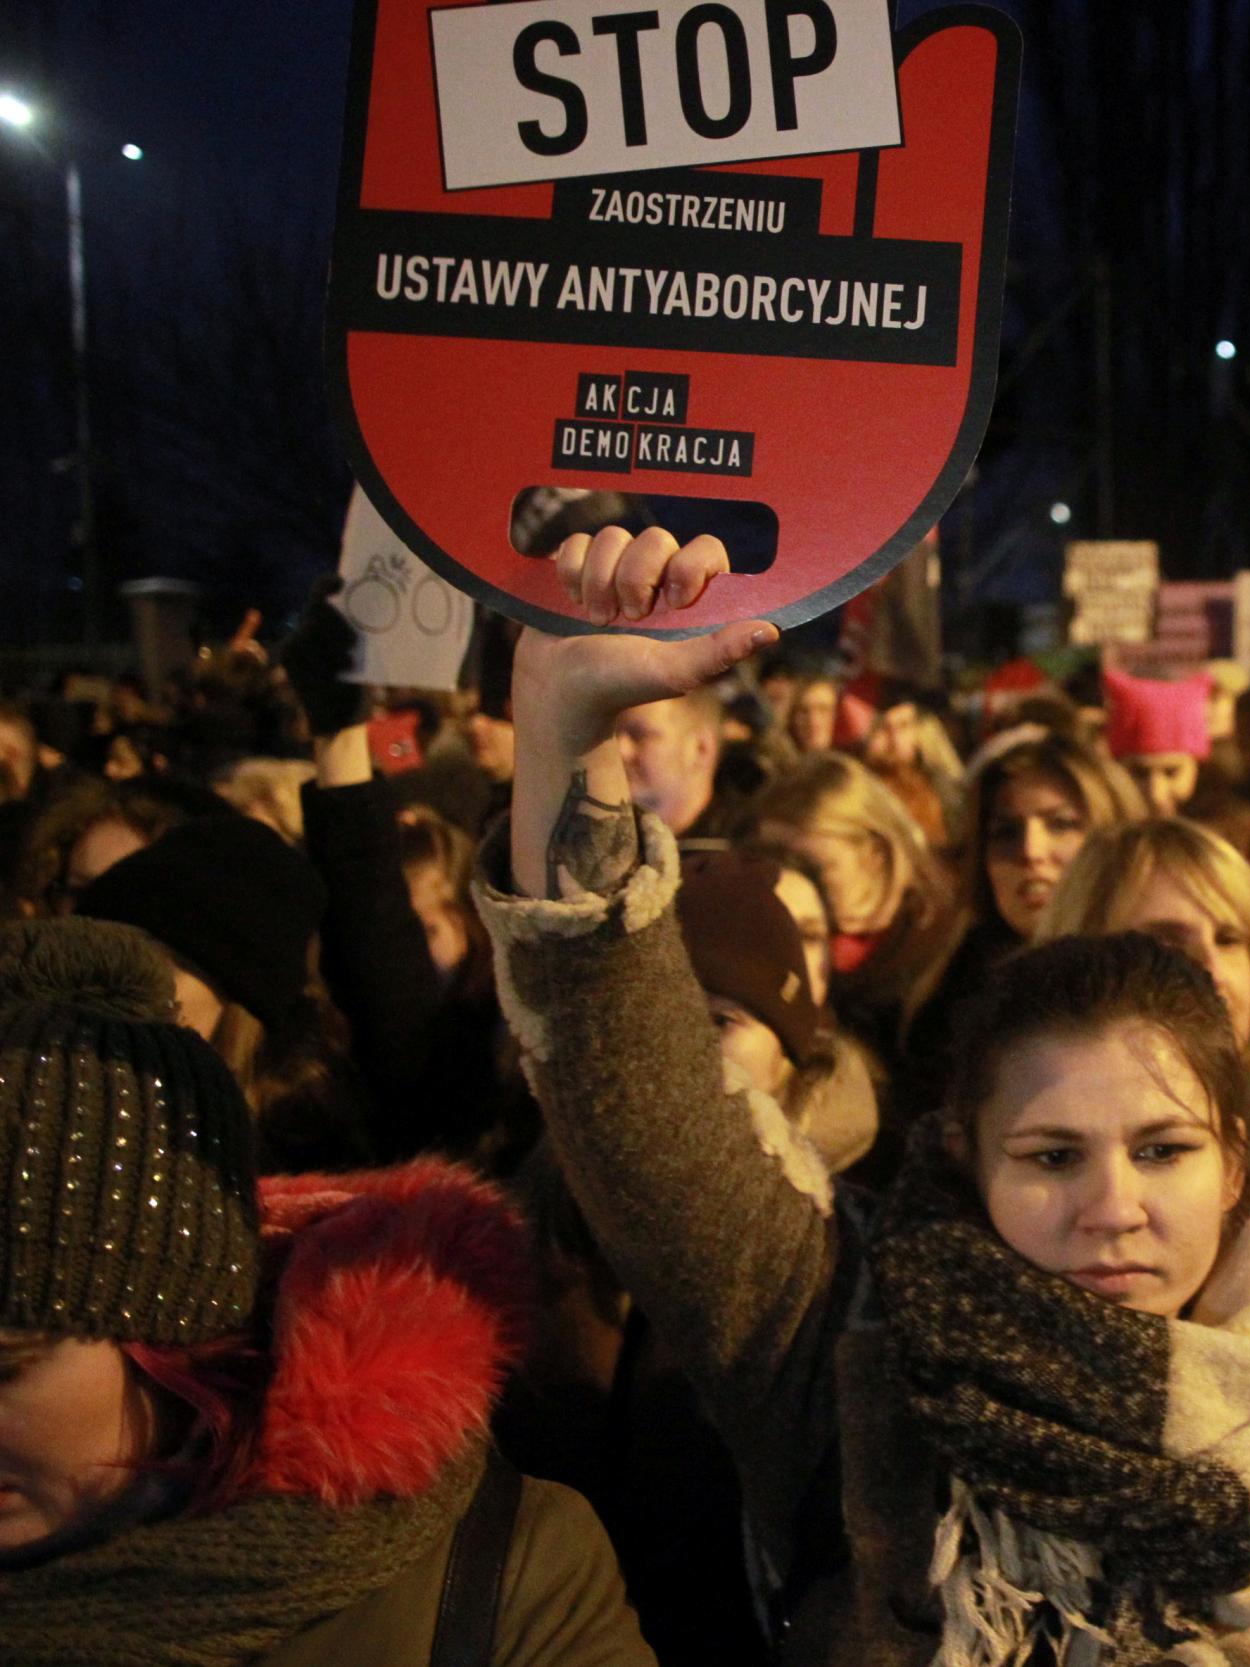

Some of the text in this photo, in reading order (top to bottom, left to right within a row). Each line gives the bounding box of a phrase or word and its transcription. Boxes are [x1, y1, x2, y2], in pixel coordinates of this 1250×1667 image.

[513, 0, 838, 156] STOP
[589, 188, 786, 234] ZAOSTRZENIU
[376, 253, 928, 330] USTAWY ANTYABORCYJNEJ
[585, 383, 676, 416] AKCJA
[562, 427, 741, 467] DEMOKRACJA
